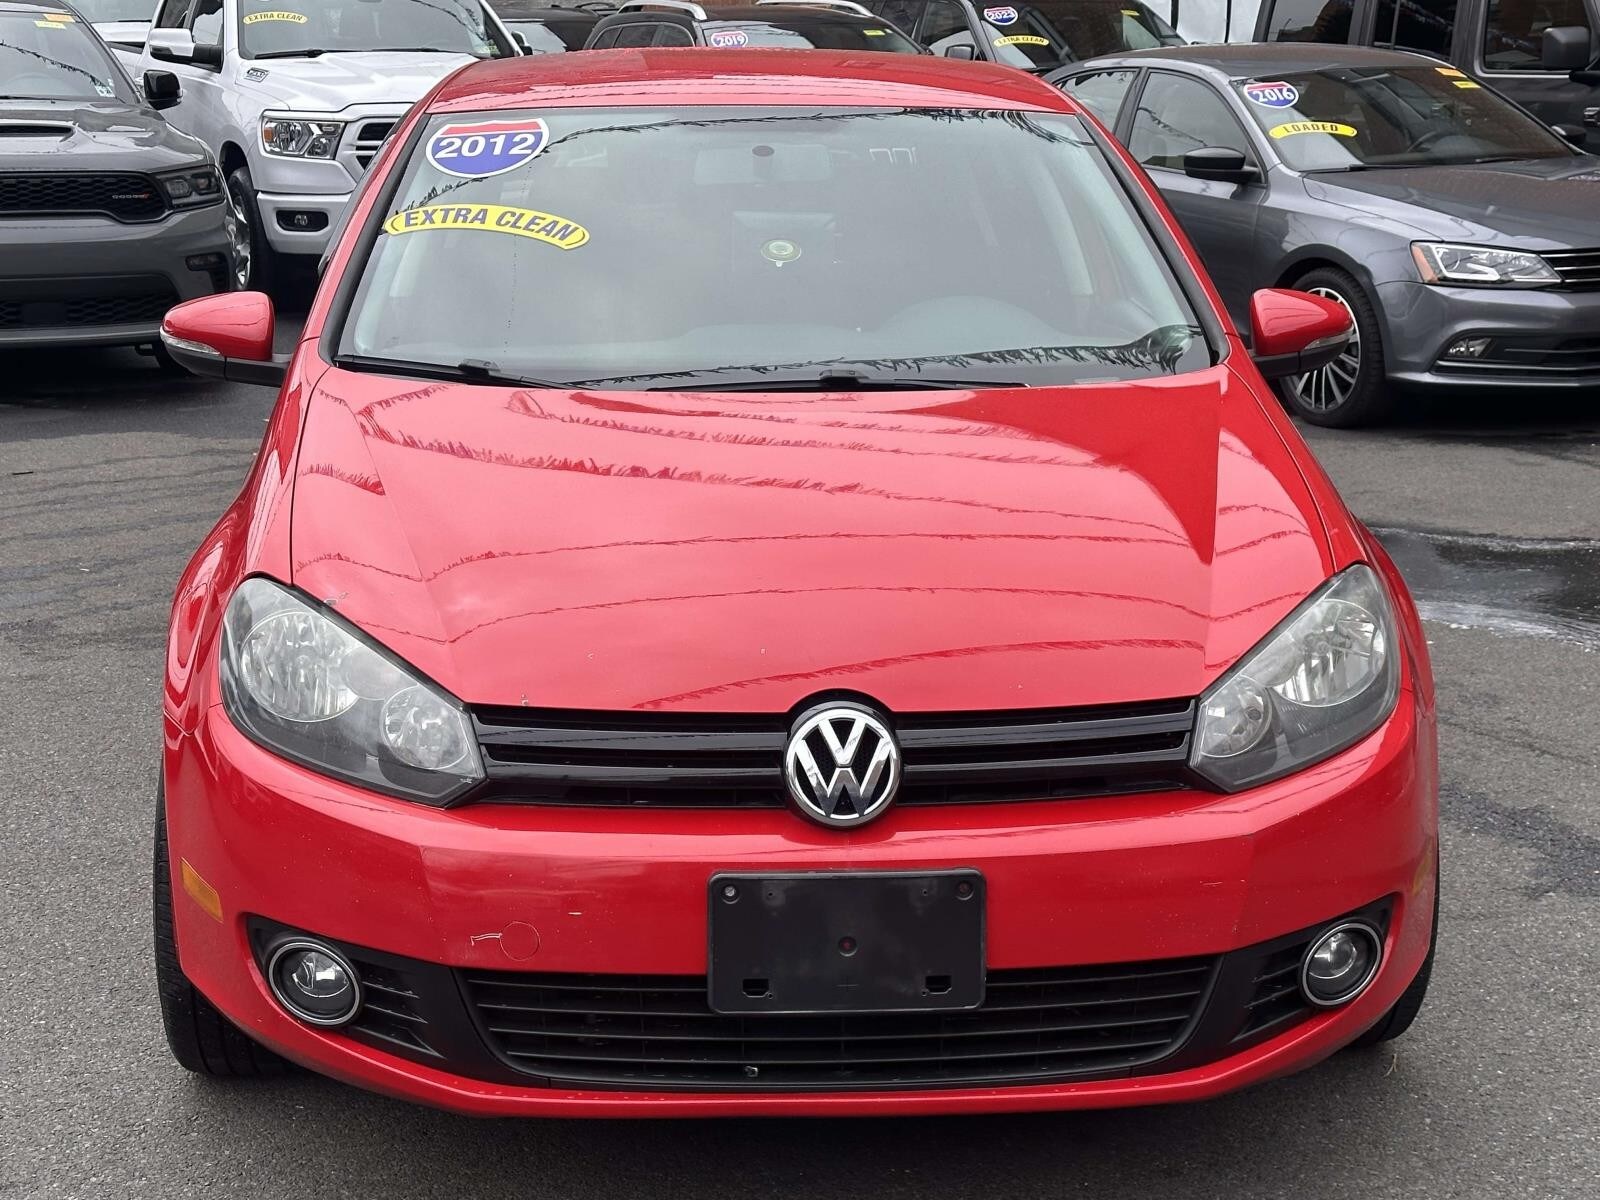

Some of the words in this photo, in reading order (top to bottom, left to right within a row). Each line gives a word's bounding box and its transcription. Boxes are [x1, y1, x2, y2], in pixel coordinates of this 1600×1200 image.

[248, 13, 274, 21] EXTRA
[277, 13, 302, 21] CLEAN
[716, 35, 745, 46] 2019
[1252, 87, 1295, 102] 2016
[1283, 123, 1339, 133] LOADED
[434, 133, 535, 159] 2012
[404, 207, 489, 228] EXTRA
[495, 210, 580, 241] CLEAN
